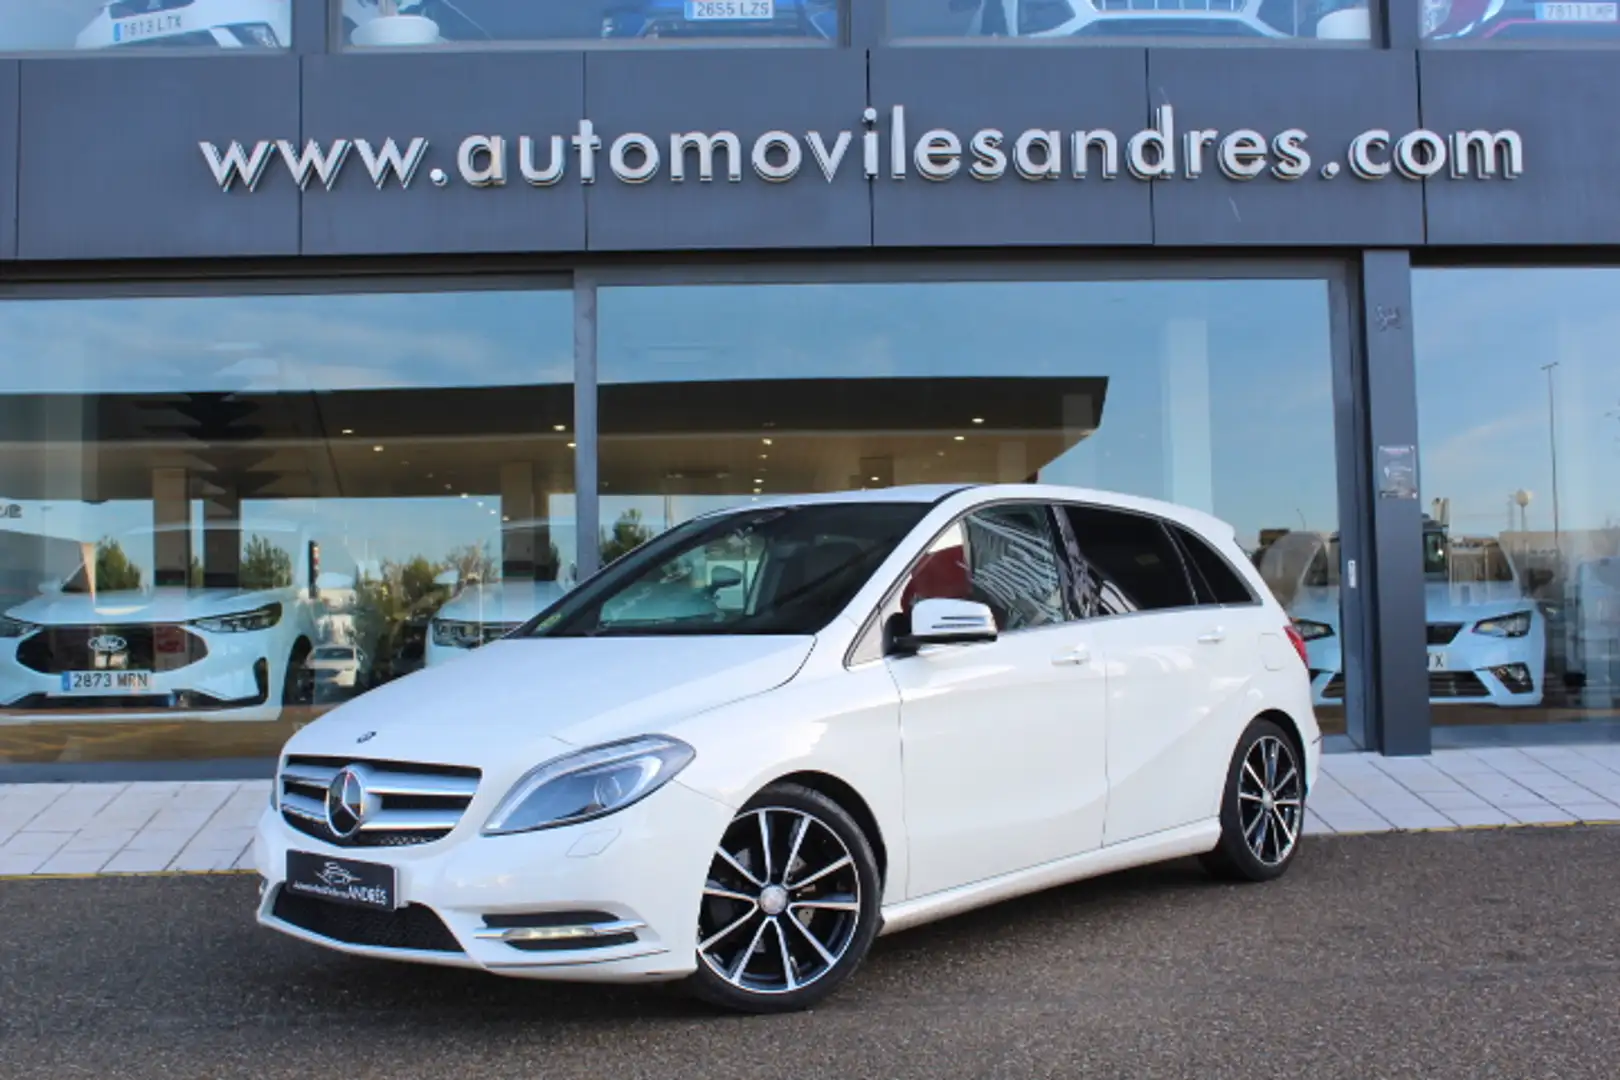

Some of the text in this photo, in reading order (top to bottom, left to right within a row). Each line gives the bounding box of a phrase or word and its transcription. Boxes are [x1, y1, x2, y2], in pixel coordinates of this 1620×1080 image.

[697, 2, 769, 17] 2655 LZS
[198, 104, 1525, 193] www.automovilesandres.com
[73, 672, 148, 688] 2873 MRN
